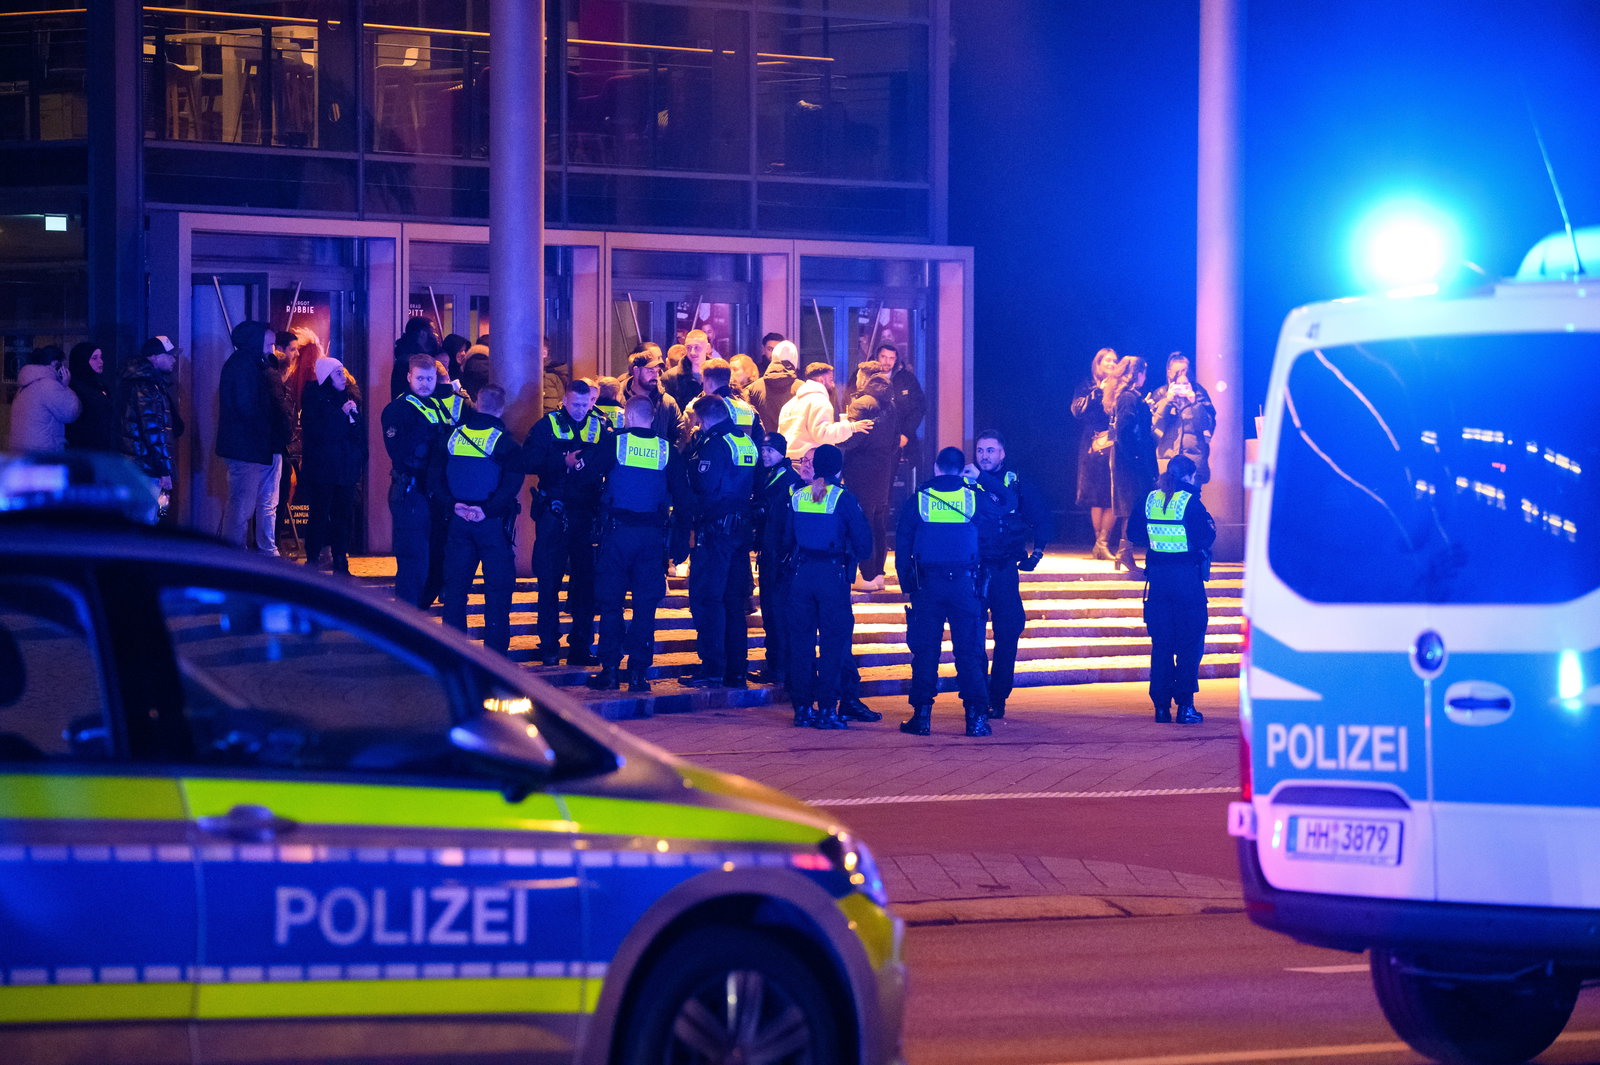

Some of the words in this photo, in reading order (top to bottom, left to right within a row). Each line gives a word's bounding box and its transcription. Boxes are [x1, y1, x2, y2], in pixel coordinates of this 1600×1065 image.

[628, 445, 658, 459] POLIZEI
[1266, 723, 1409, 772] POLIZEI
[1341, 824, 1389, 852] 3879
[275, 886, 528, 946] POLIZEI
